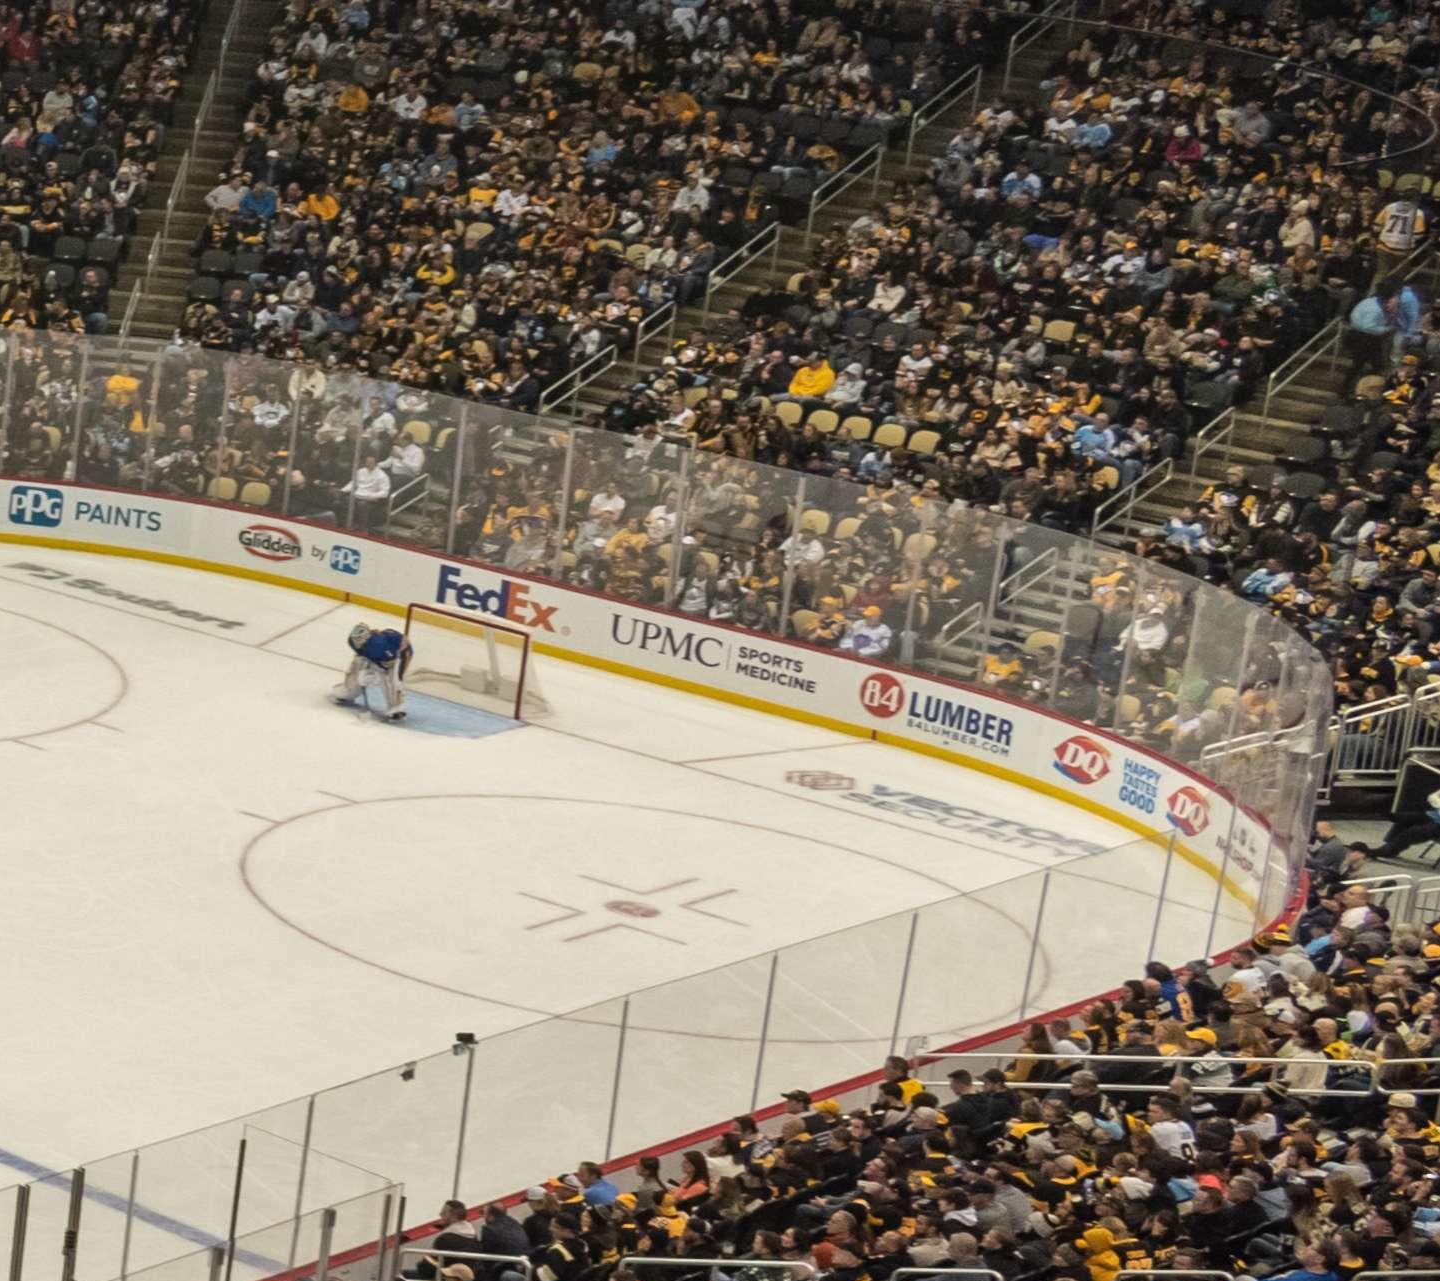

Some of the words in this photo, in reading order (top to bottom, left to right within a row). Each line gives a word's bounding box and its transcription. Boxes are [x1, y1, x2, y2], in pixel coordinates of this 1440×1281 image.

[11, 488, 64, 523] PPG
[74, 501, 163, 532] PAINTS
[239, 530, 302, 558] Glidden
[311, 545, 327, 561] by
[436, 564, 559, 633] FedEx
[611, 613, 724, 668] UPMC
[738, 645, 804, 673] SPORTS
[735, 662, 817, 693] MEDICINE
[863, 679, 901, 713] 84
[908, 691, 1014, 747] LUMBER
[906, 717, 1010, 758] 84LUMBER.COM
[1062, 742, 1105, 781] DQ
[1123, 757, 1162, 785] HAPPY
[1118, 785, 1156, 814] GOOD
[1122, 772, 1157, 799] TASTES
[841, 790, 1080, 858] SECURITY
[871, 783, 1106, 856] VECTOR
[1174, 794, 1207, 827] DQ
